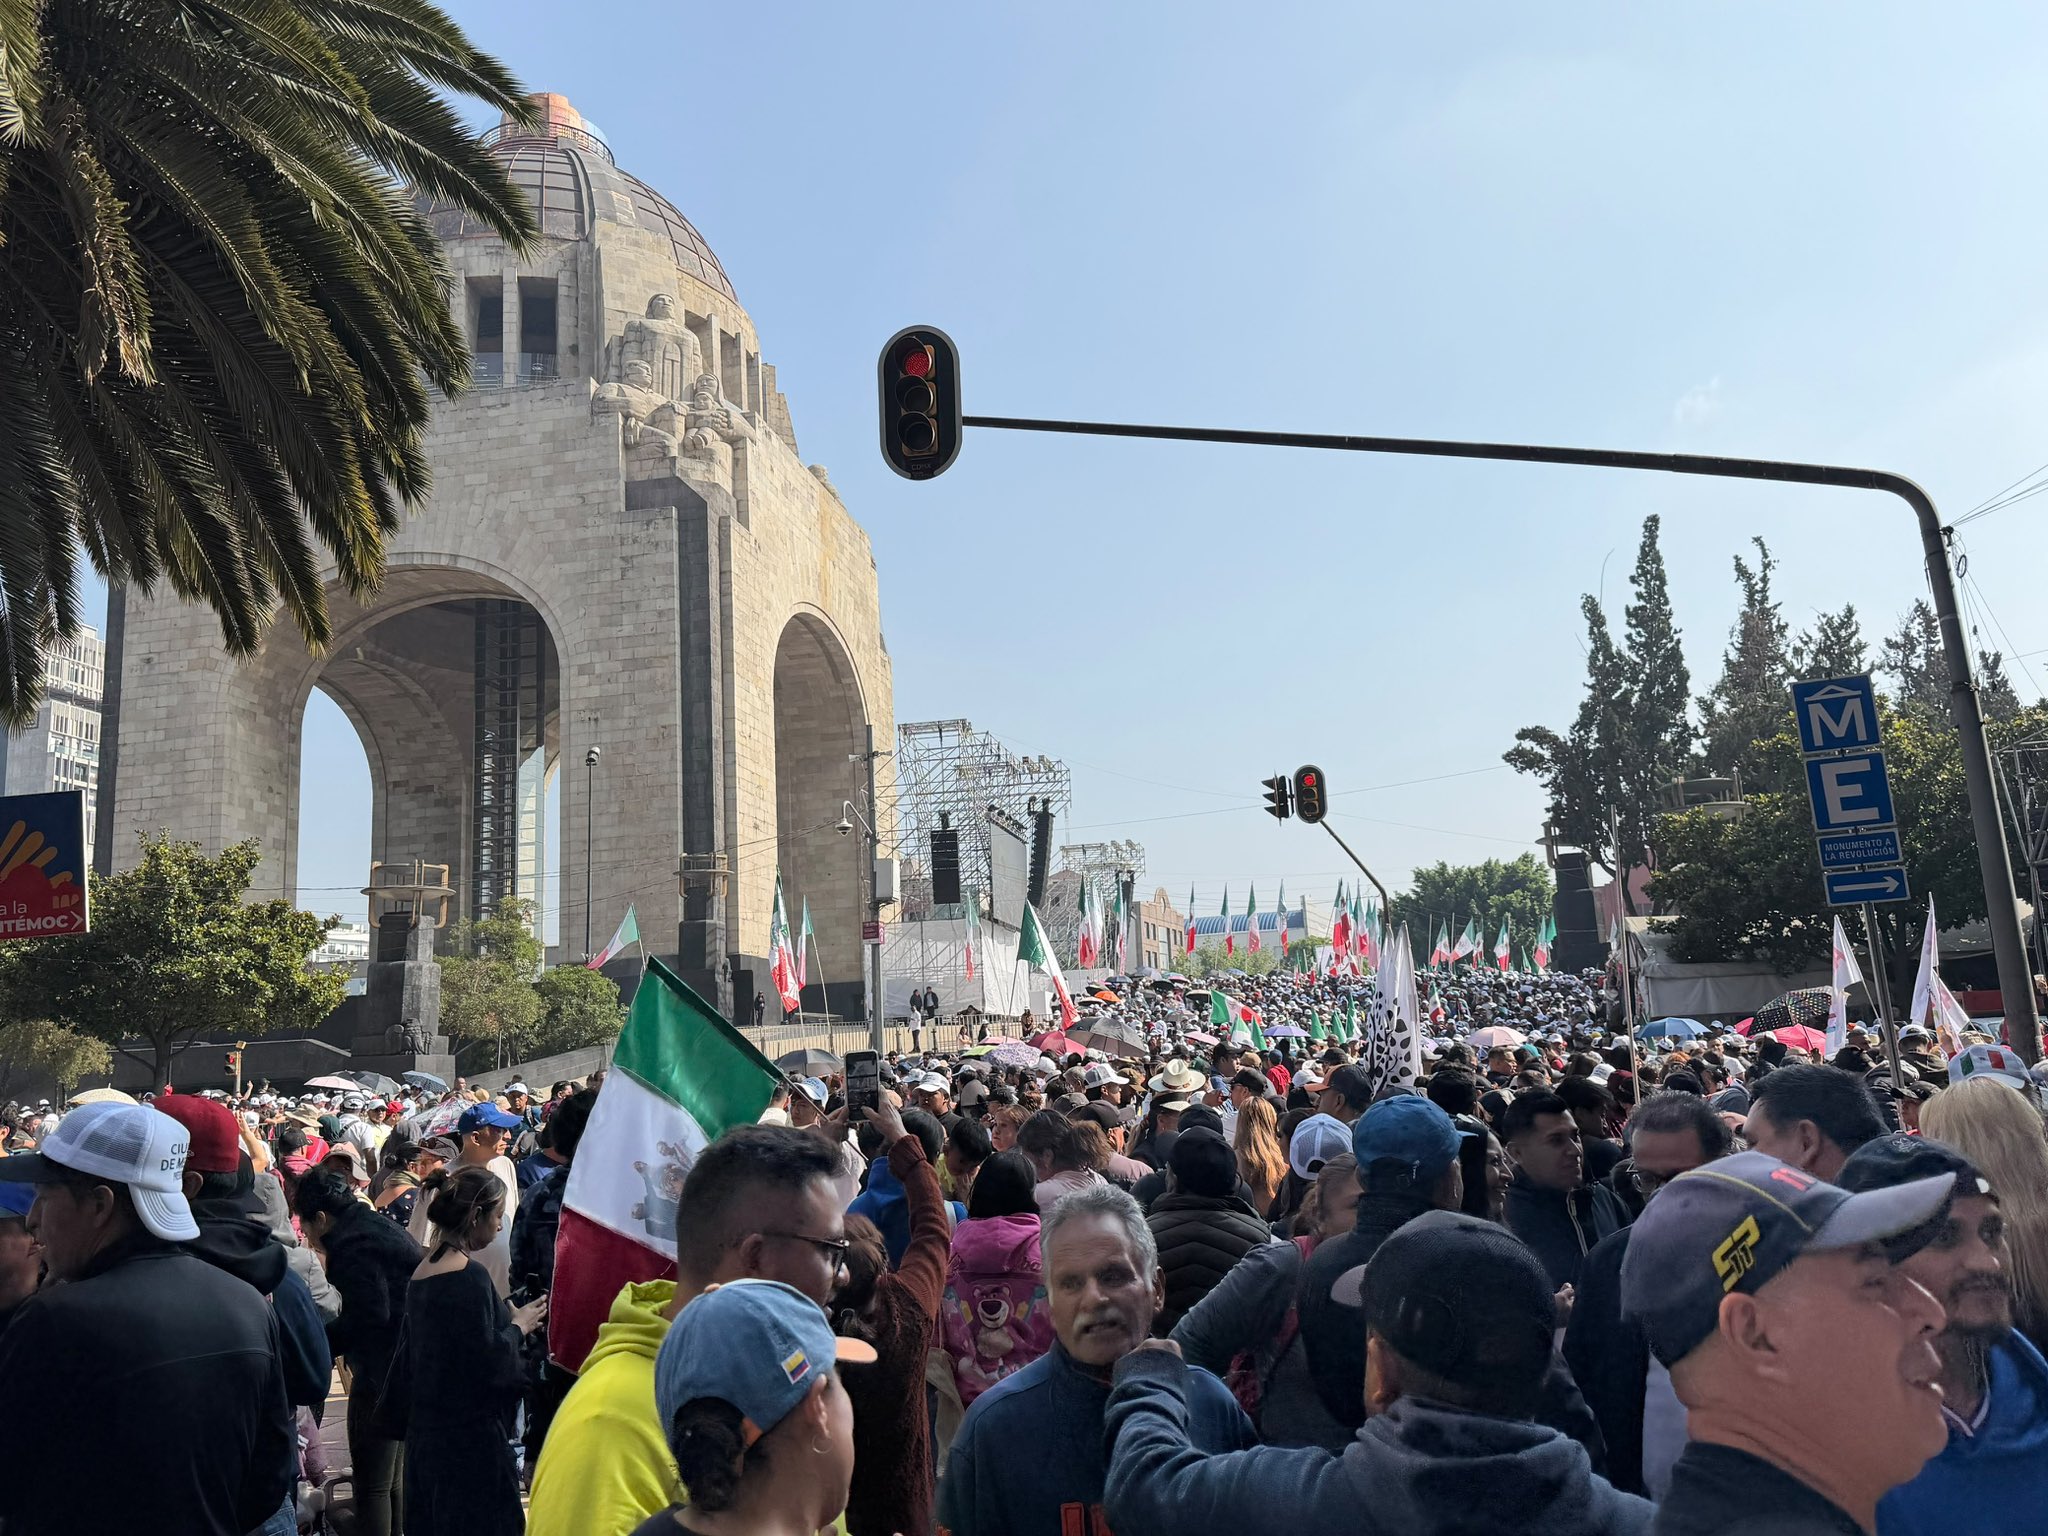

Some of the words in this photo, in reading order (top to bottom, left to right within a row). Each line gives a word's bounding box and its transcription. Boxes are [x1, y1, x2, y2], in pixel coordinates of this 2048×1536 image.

[1807, 698, 1868, 747] M
[1820, 758, 1880, 825] E
[1825, 839, 1882, 852] MONUMENTO
[1885, 838, 1892, 846] A
[1825, 852, 1837, 861] LA
[1840, 846, 1896, 859] REVOLUCIÓN
[13, 900, 28, 915] la
[160, 1158, 175, 1171] DE
